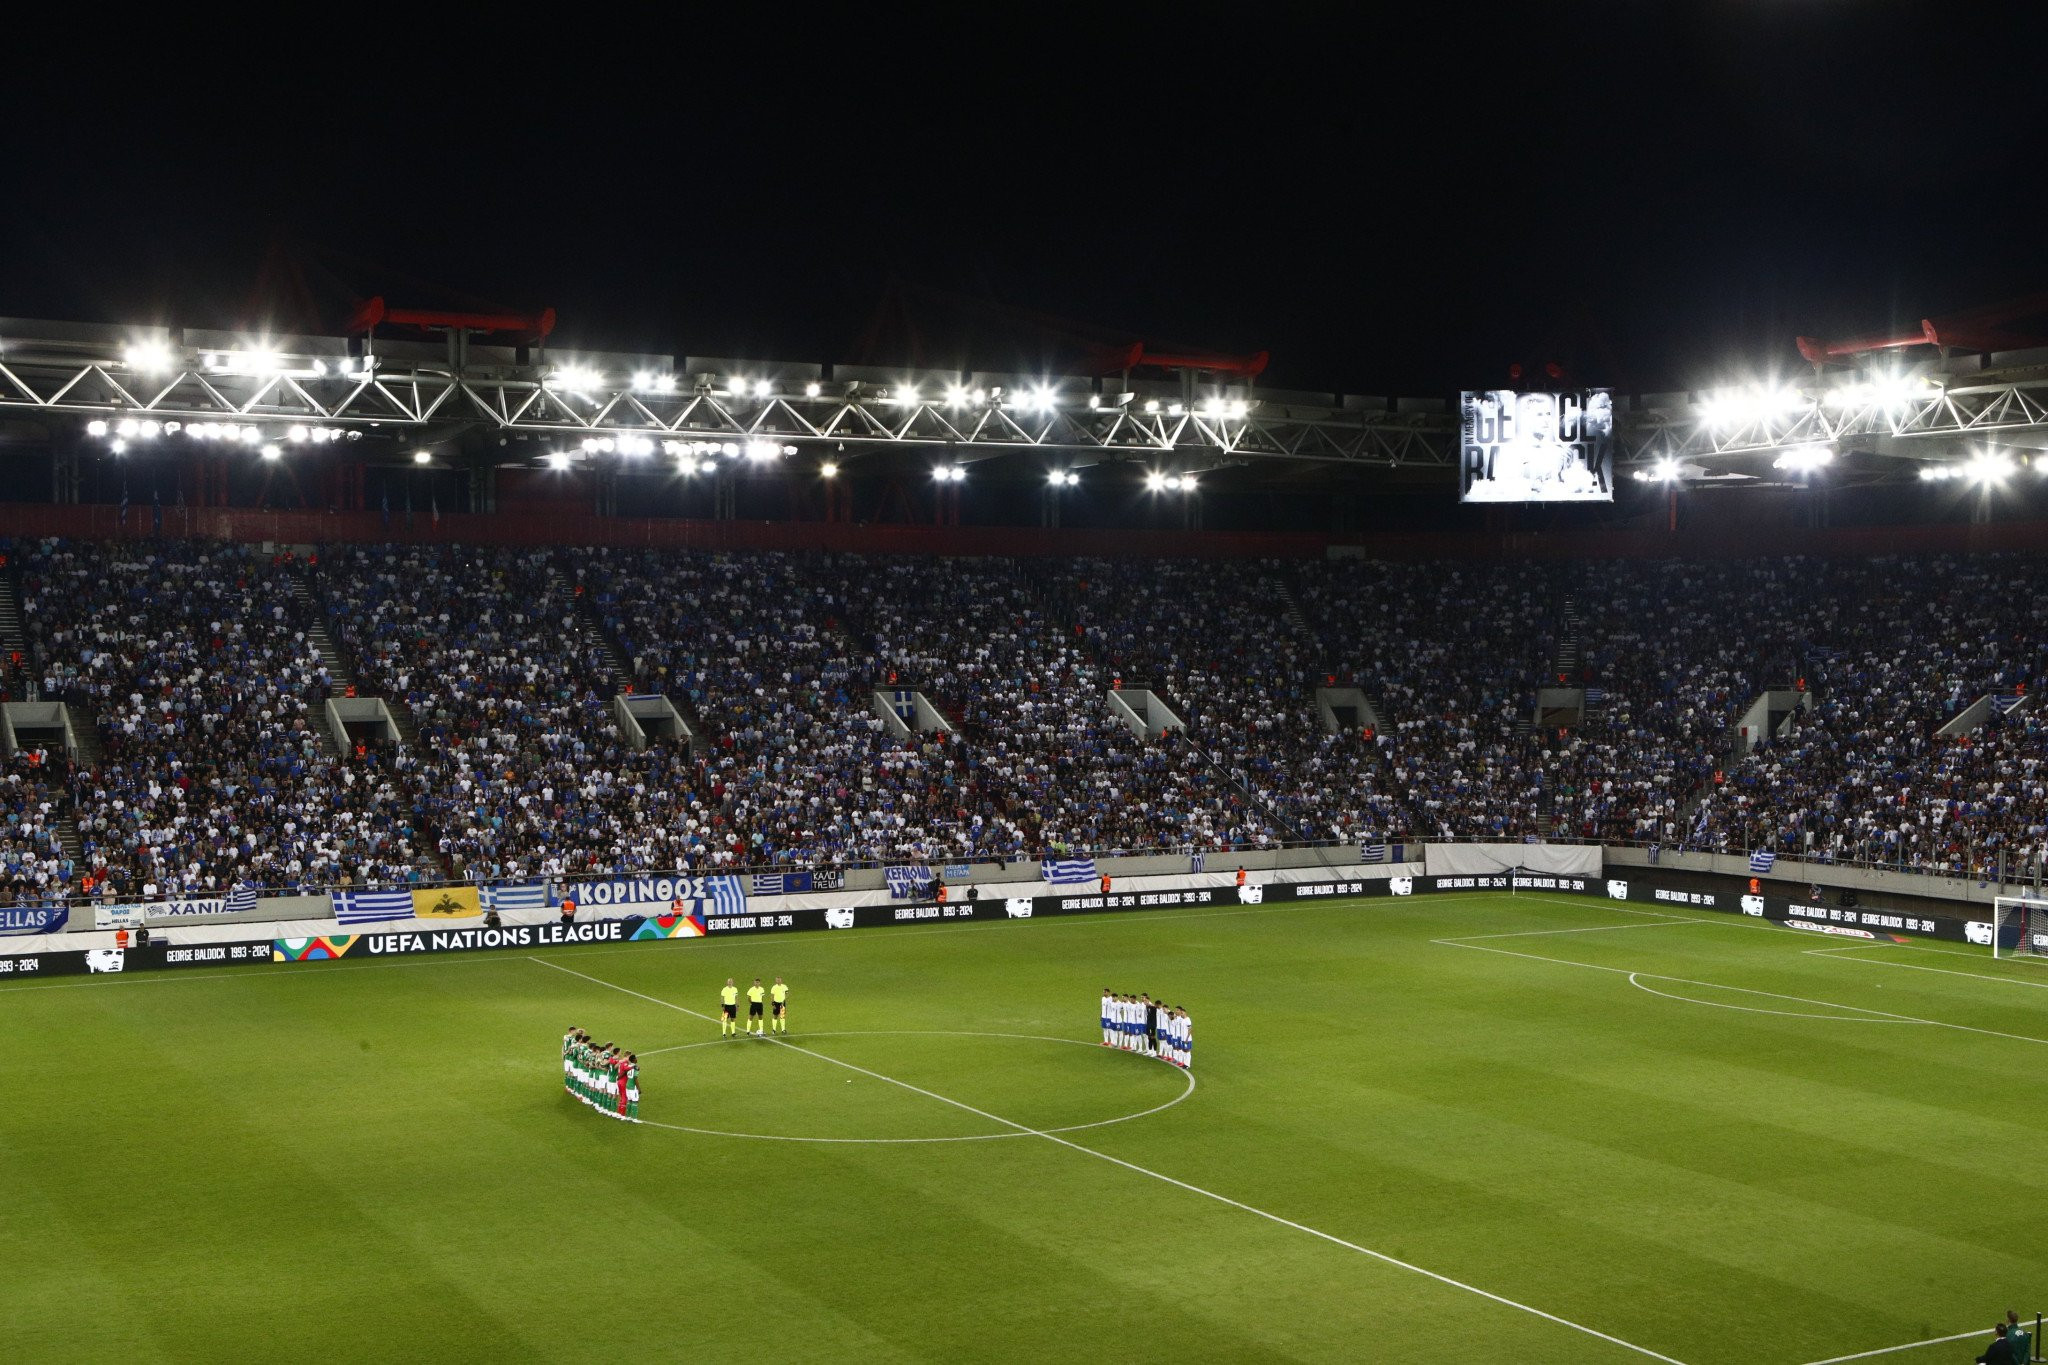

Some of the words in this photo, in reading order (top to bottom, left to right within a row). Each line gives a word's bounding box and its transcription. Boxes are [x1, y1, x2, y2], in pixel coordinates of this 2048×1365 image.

[1465, 395, 1474, 404] OF
[1465, 405, 1474, 436] MEMORY
[813, 871, 836, 880] ΚΑΛΟ
[885, 866, 932, 880] KEFALONIA
[1296, 886, 1313, 895] GEORGE
[1314, 885, 1334, 894] BALDOCK
[1337, 884, 1347, 893] 1993
[1351, 884, 1362, 892] 2024
[1437, 878, 1453, 888] GEORGE
[1454, 878, 1474, 887] BALDOCK
[1478, 878, 1489, 886] 1993
[1513, 878, 1532, 887] GEORGE
[1534, 878, 1556, 888] BALDOCK
[1559, 880, 1569, 889] 1993
[1573, 880, 1584, 890] 2024
[578, 877, 706, 904] ΚΟΡΙΝΘΟΣ
[1656, 890, 1670, 900] GEORGE
[1670, 890, 1688, 902] BALDOCK
[1691, 893, 1700, 903] 1993
[1704, 895, 1714, 905] 2024
[1062, 898, 1080, 909] GEORGE
[1082, 897, 1104, 908] BALDOCK
[1107, 897, 1118, 907] 1993
[1122, 896, 1134, 906] 2024
[1140, 894, 1158, 905] GEORGE
[1160, 894, 1180, 904] BALDOCK
[1199, 892, 1211, 901] 2024
[895, 909, 915, 920] GEORGE
[916, 908, 939, 918] BALDOCK
[943, 906, 955, 916] 1993
[960, 906, 973, 915] 2024
[1789, 905, 1806, 916] GEORGE
[1807, 906, 1827, 918] BALDOCK
[1830, 910, 1841, 920] 1993
[1845, 911, 1856, 922] 2024
[708, 917, 729, 930] GEORGE
[730, 916, 756, 928] BALDOCK
[760, 916, 774, 927] 1993
[779, 915, 792, 926] 2024
[1862, 914, 1880, 926] GEORGE
[1880, 916, 1902, 928] BALDOCK
[1906, 918, 1918, 930] 1993
[1921, 920, 1934, 932] 2024
[368, 934, 425, 953] UEFA
[432, 928, 530, 949] NATIONS
[538, 922, 622, 943] LEAGUE
[167, 951, 193, 962] GEORGE
[195, 948, 226, 960] BALDOCK
[231, 947, 247, 958] 1993
[253, 945, 270, 957] 2024
[20, 959, 38, 971] 2024
